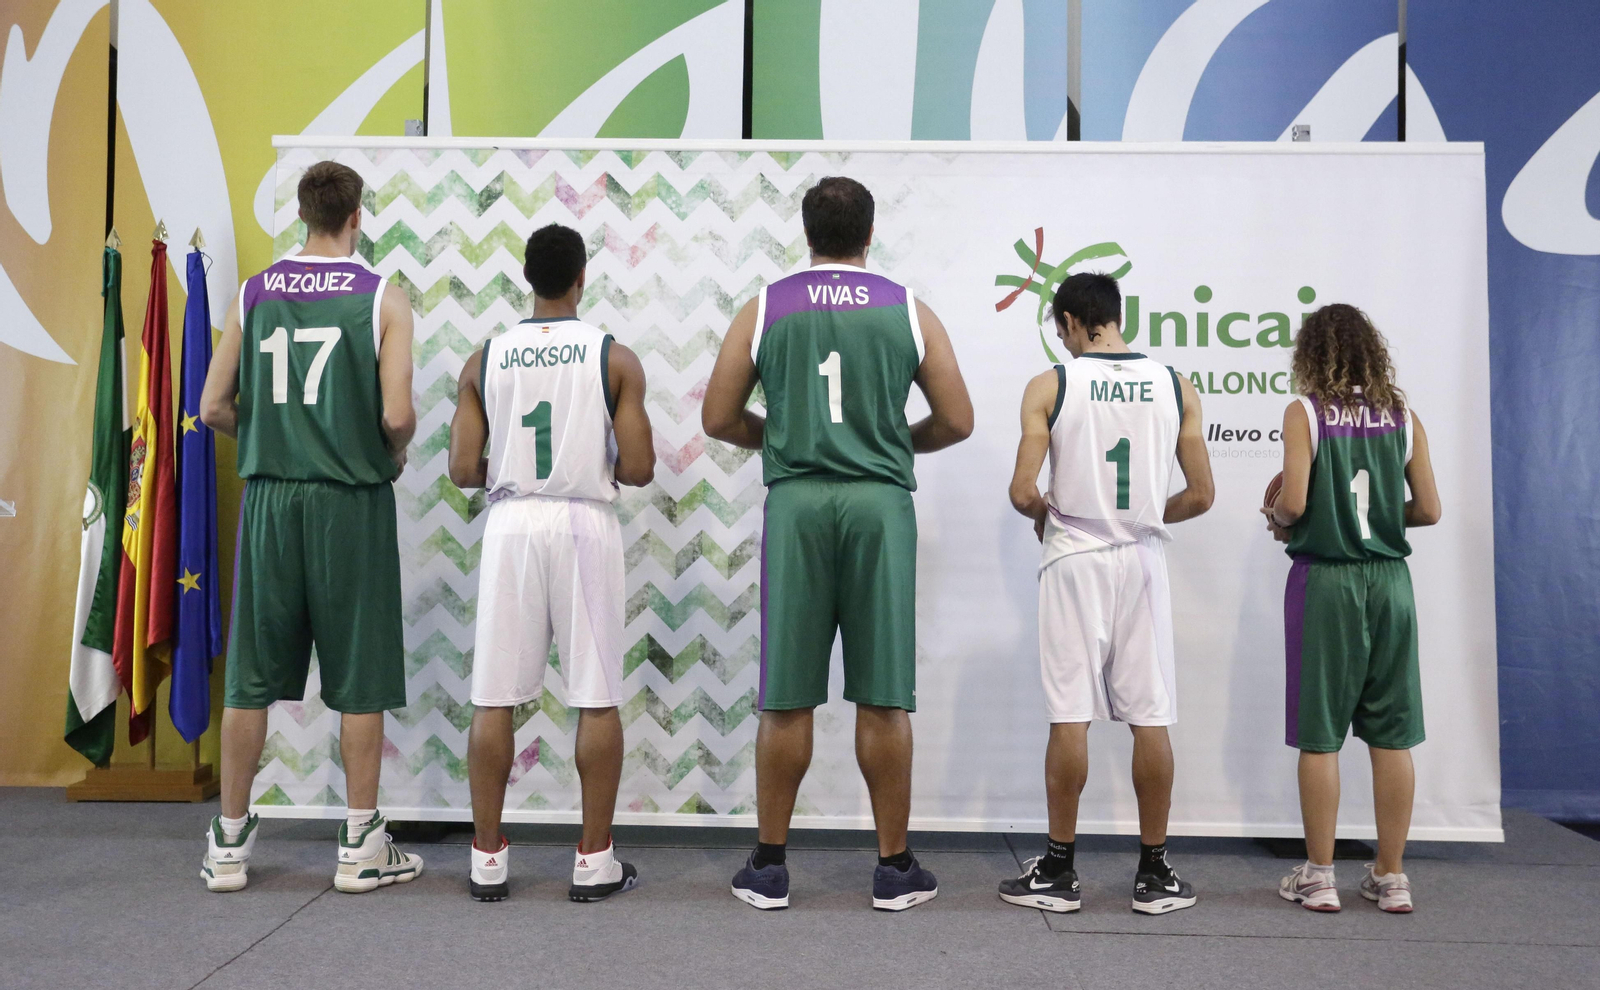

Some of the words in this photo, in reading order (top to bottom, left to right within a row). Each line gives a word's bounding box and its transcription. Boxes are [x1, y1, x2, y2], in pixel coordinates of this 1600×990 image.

[262, 271, 355, 293] VAZQUEZ
[807, 285, 869, 305] VIVAS
[259, 326, 342, 405] 17
[500, 344, 587, 370] JACKSON
[818, 351, 843, 424] 1
[1090, 380, 1154, 402] MATE
[1175, 371, 1298, 395] ALONC
[522, 400, 553, 480] 1
[1207, 423, 1262, 442] llevo
[1105, 437, 1131, 510] 1
[1350, 469, 1372, 540] 1
